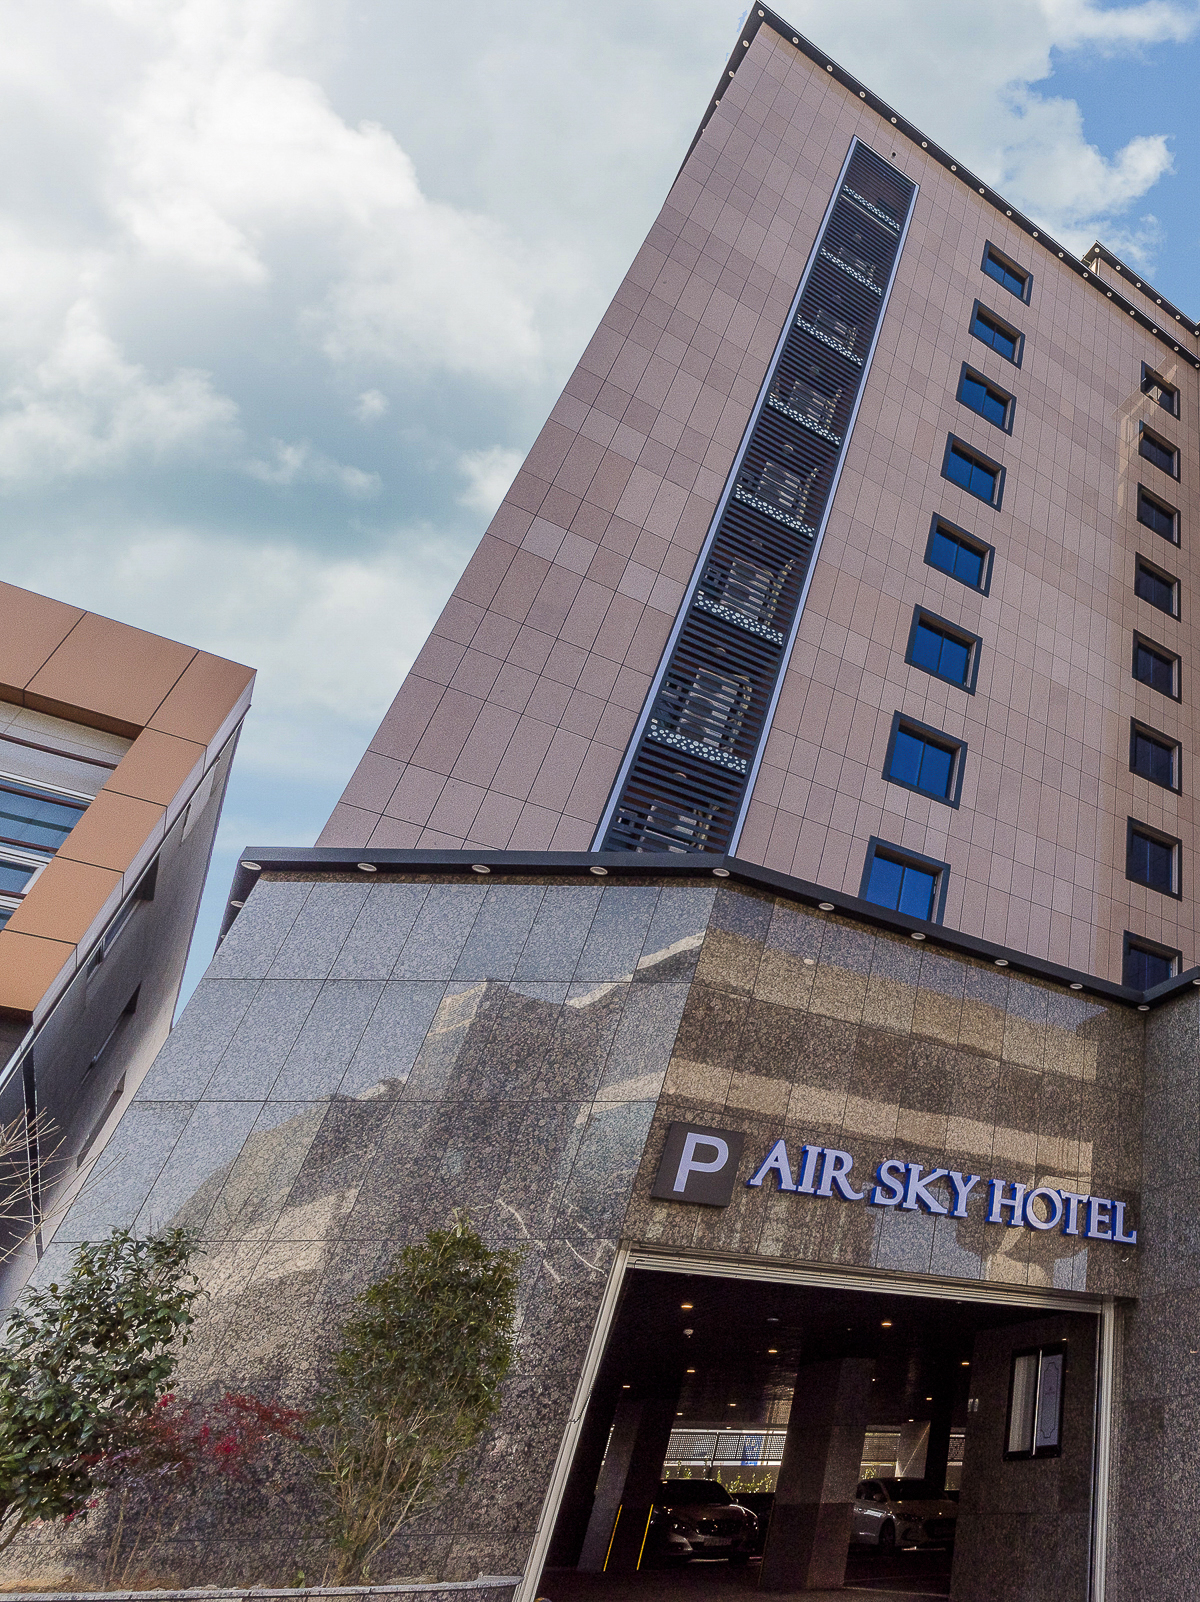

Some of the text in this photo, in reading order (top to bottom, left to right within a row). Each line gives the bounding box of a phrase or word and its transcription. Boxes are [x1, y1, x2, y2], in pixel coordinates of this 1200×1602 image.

[673, 1131, 729, 1193] P
[746, 1138, 1138, 1245] AIR SKY HOTEL
